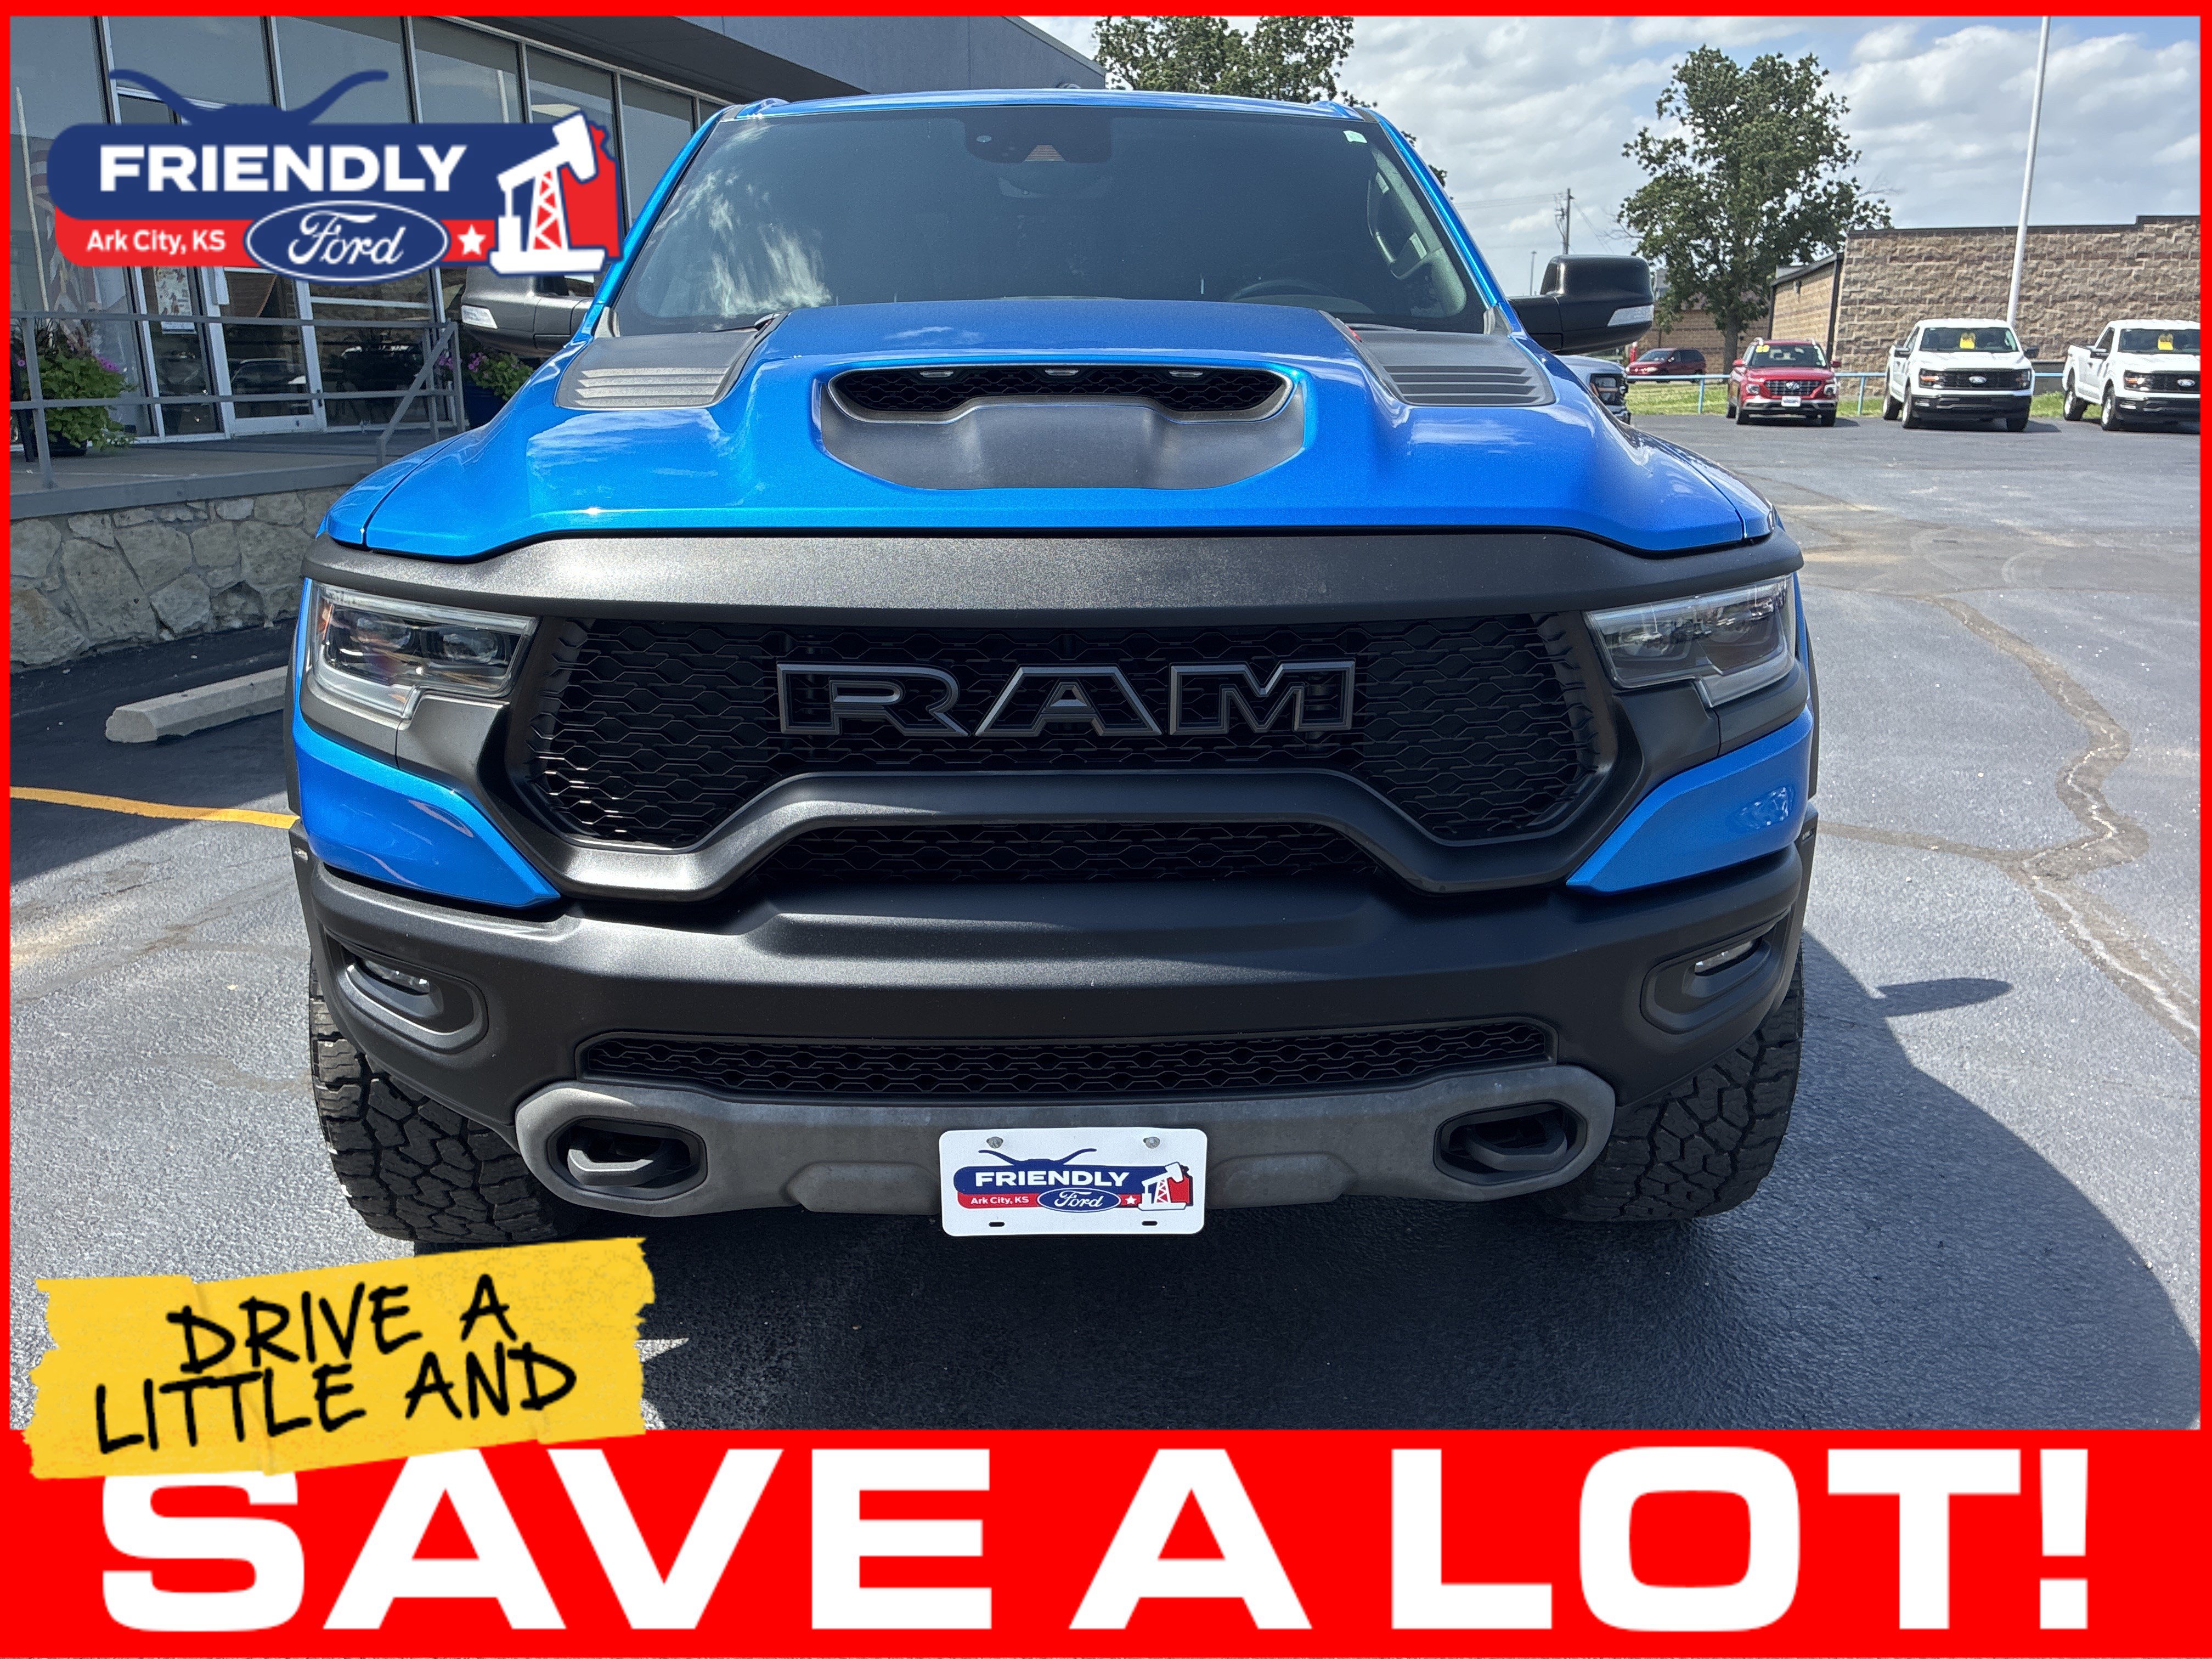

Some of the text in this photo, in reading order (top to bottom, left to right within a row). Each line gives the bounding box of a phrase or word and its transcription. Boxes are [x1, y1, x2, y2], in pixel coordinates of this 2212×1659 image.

[776, 662, 1356, 737] RAM
[975, 1170, 1130, 1187] FRIENDLY
[970, 1197, 988, 1205] Ark
[990, 1197, 1013, 1205] City,
[1054, 1190, 1104, 1207] Ford
